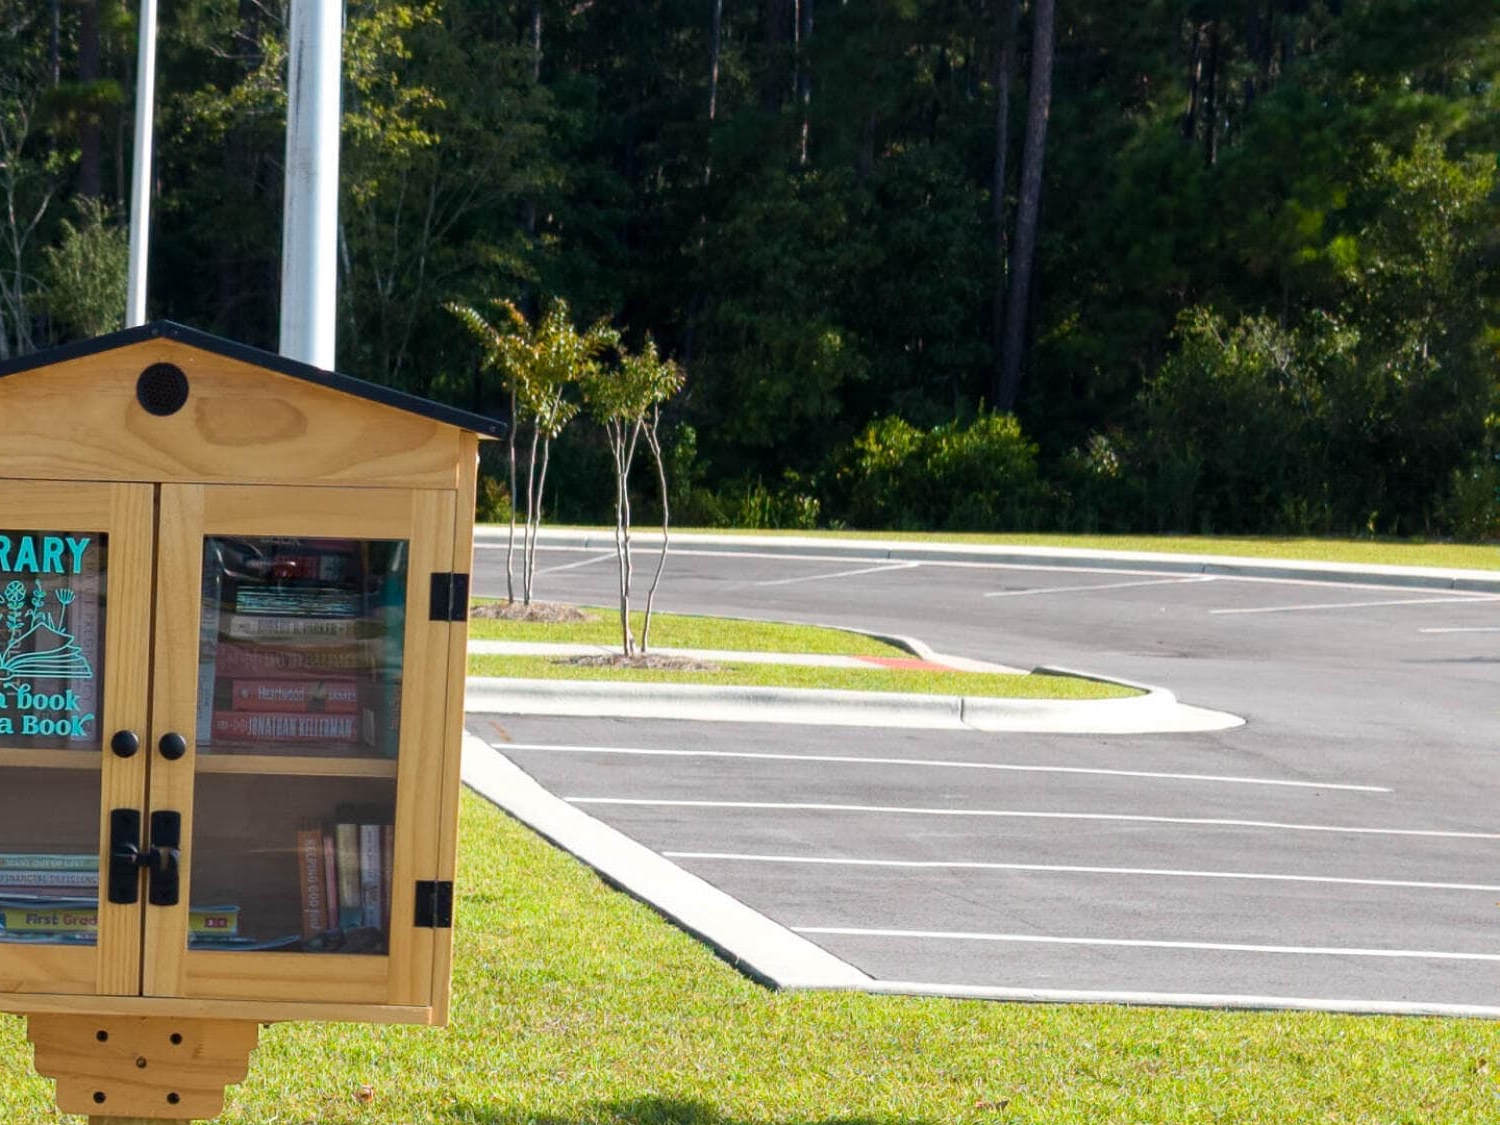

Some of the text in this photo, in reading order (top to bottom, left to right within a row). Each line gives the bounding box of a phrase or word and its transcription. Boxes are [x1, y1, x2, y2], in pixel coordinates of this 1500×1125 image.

[4, 682, 80, 711] book
[22, 713, 95, 737] Book
[26, 912, 58, 925] First
